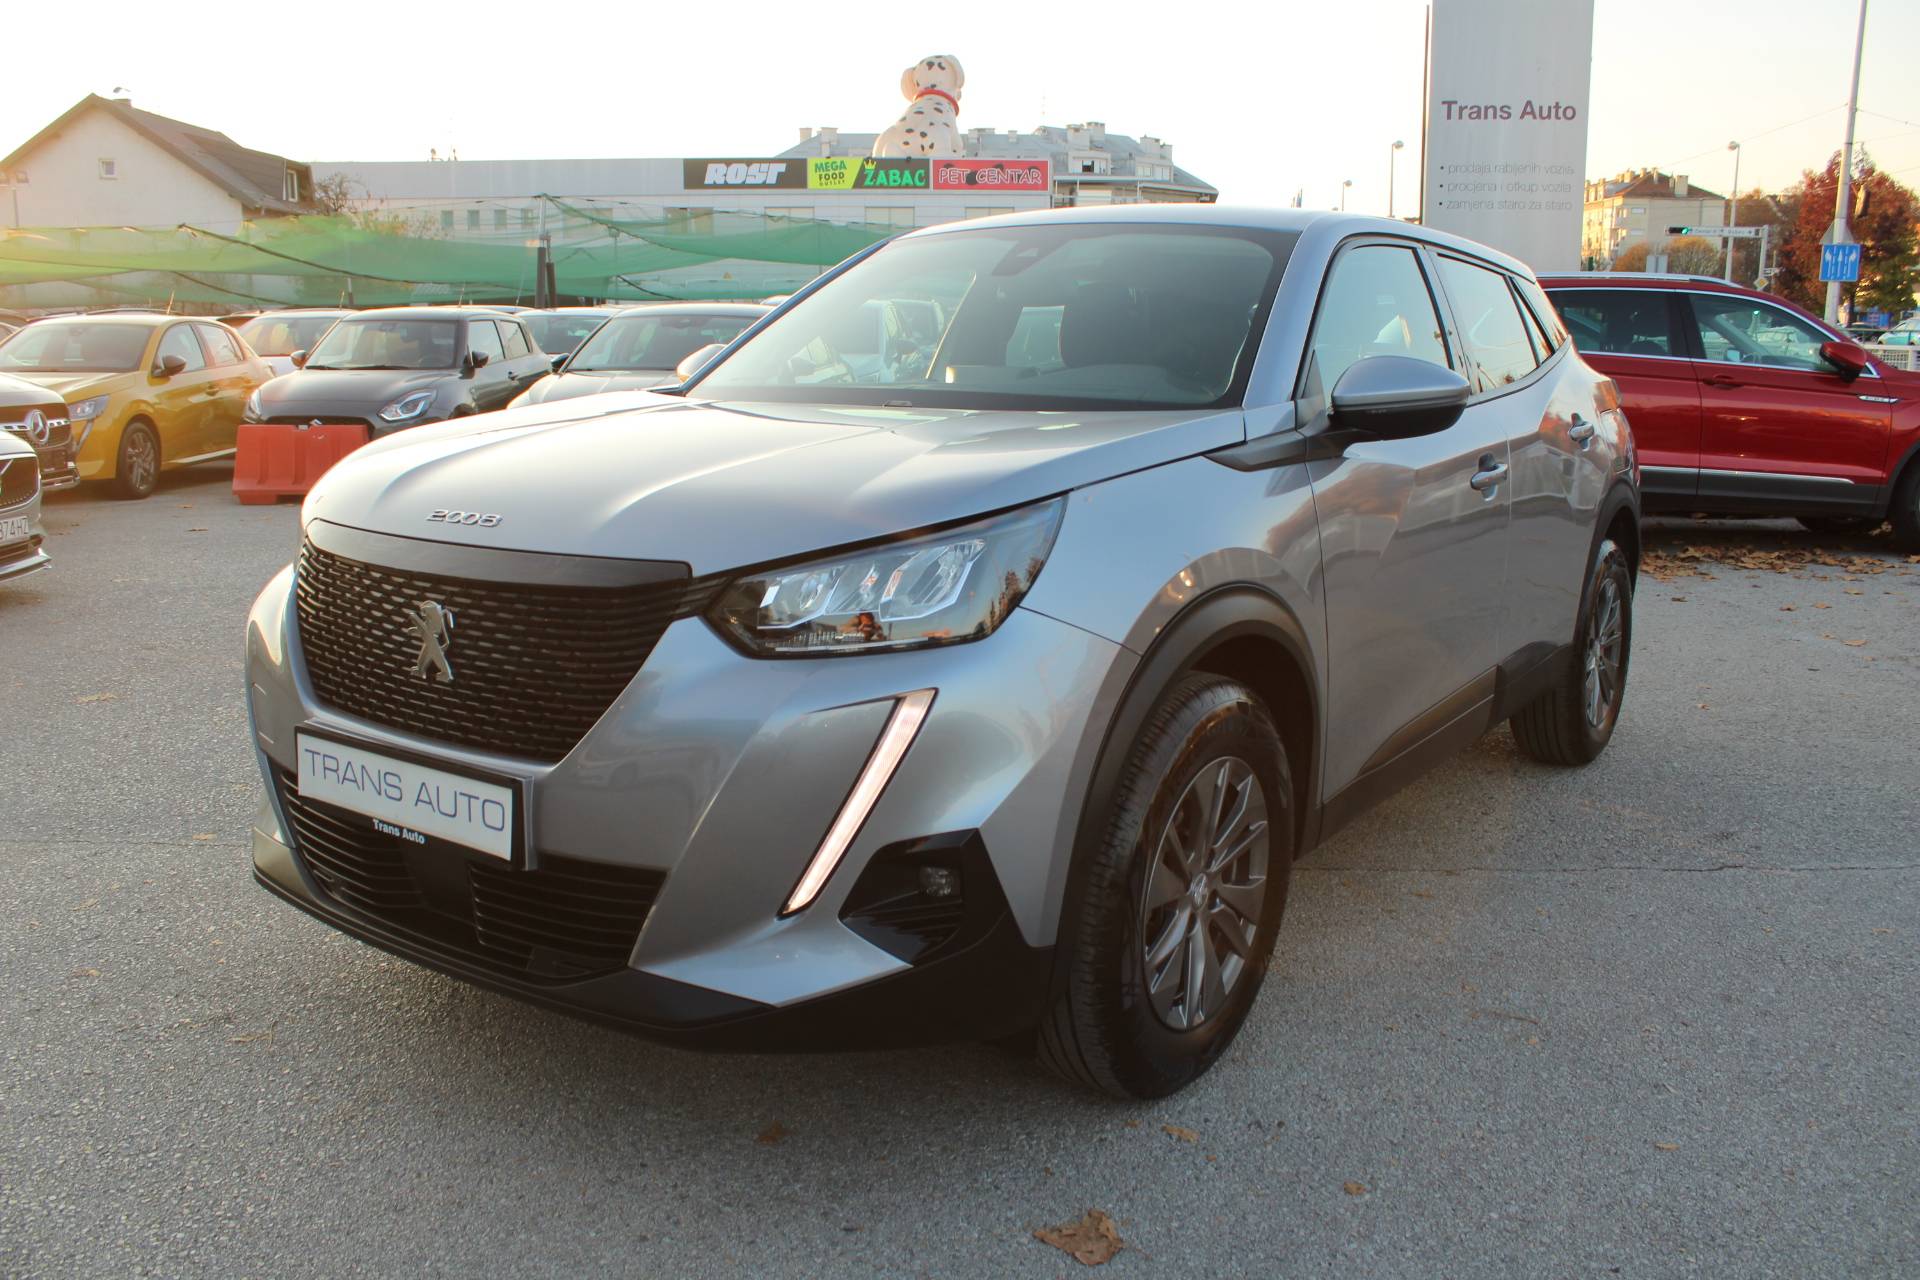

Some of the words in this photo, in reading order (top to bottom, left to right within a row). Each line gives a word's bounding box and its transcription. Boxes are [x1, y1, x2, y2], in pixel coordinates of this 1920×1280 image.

[1441, 100, 1512, 121] Trans
[1519, 100, 1577, 121] Auto
[814, 160, 847, 173] MEGA
[938, 168, 971, 184] PET
[975, 168, 1042, 185] CENTAR
[818, 172, 845, 182] FOOD
[426, 508, 503, 528] 2008
[304, 748, 403, 802] TRANS
[415, 781, 505, 832] AUTO
[372, 818, 400, 837] Trans
[402, 828, 425, 845] Auto
